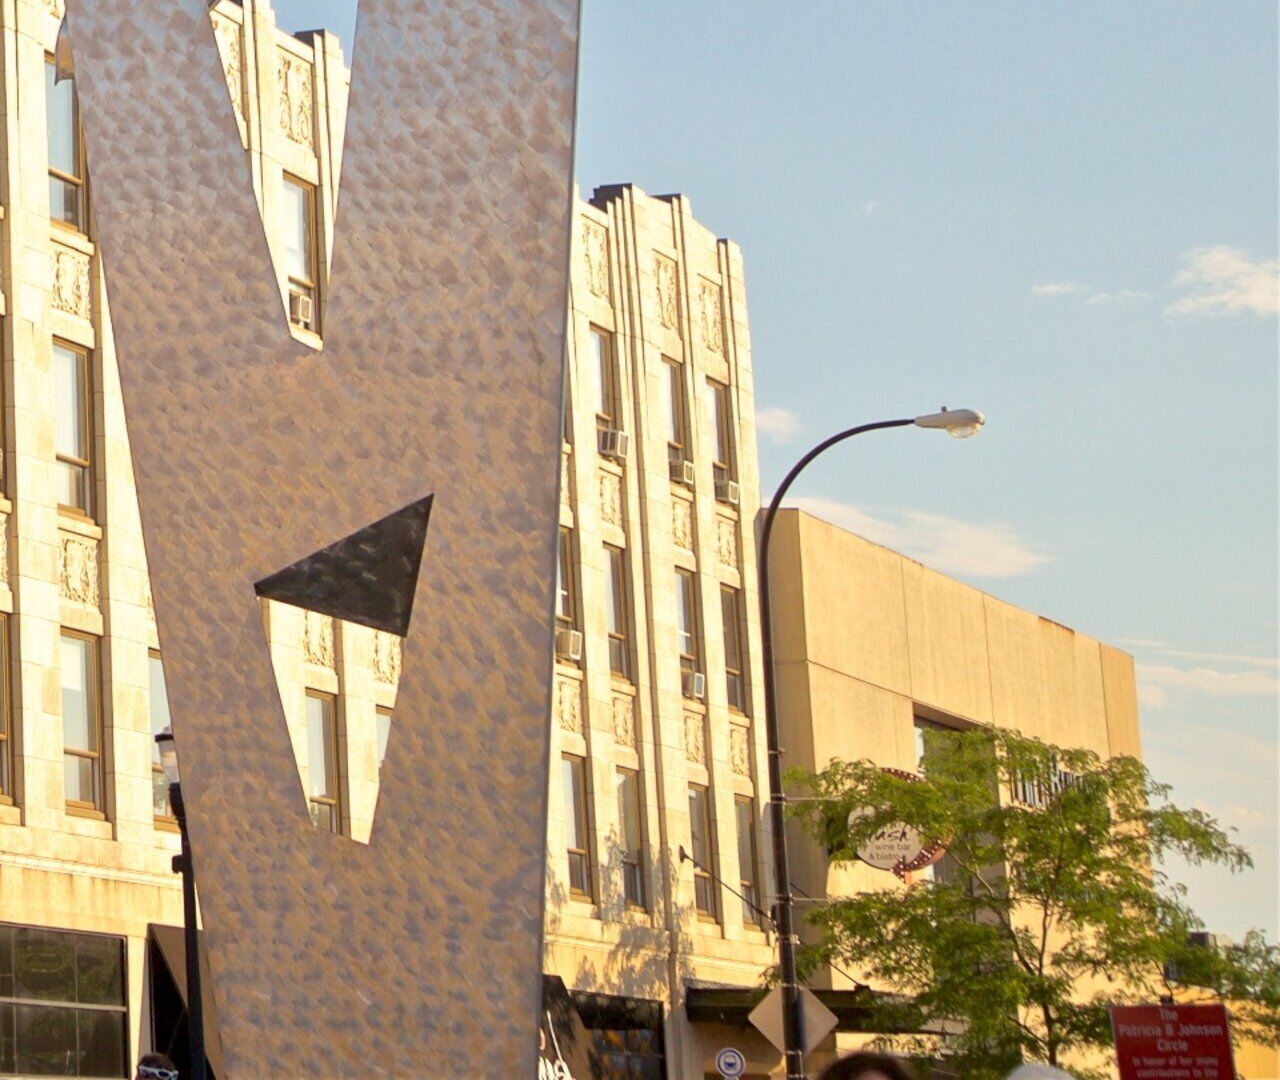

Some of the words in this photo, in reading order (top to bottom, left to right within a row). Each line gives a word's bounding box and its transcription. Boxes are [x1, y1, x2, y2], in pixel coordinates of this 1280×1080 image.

[897, 843, 911, 851] bar
[1160, 1009, 1178, 1021] The
[1119, 1024, 1161, 1036] Patricia
[1178, 1024, 1223, 1036] Johnson
[1157, 1040, 1188, 1052] Circle
